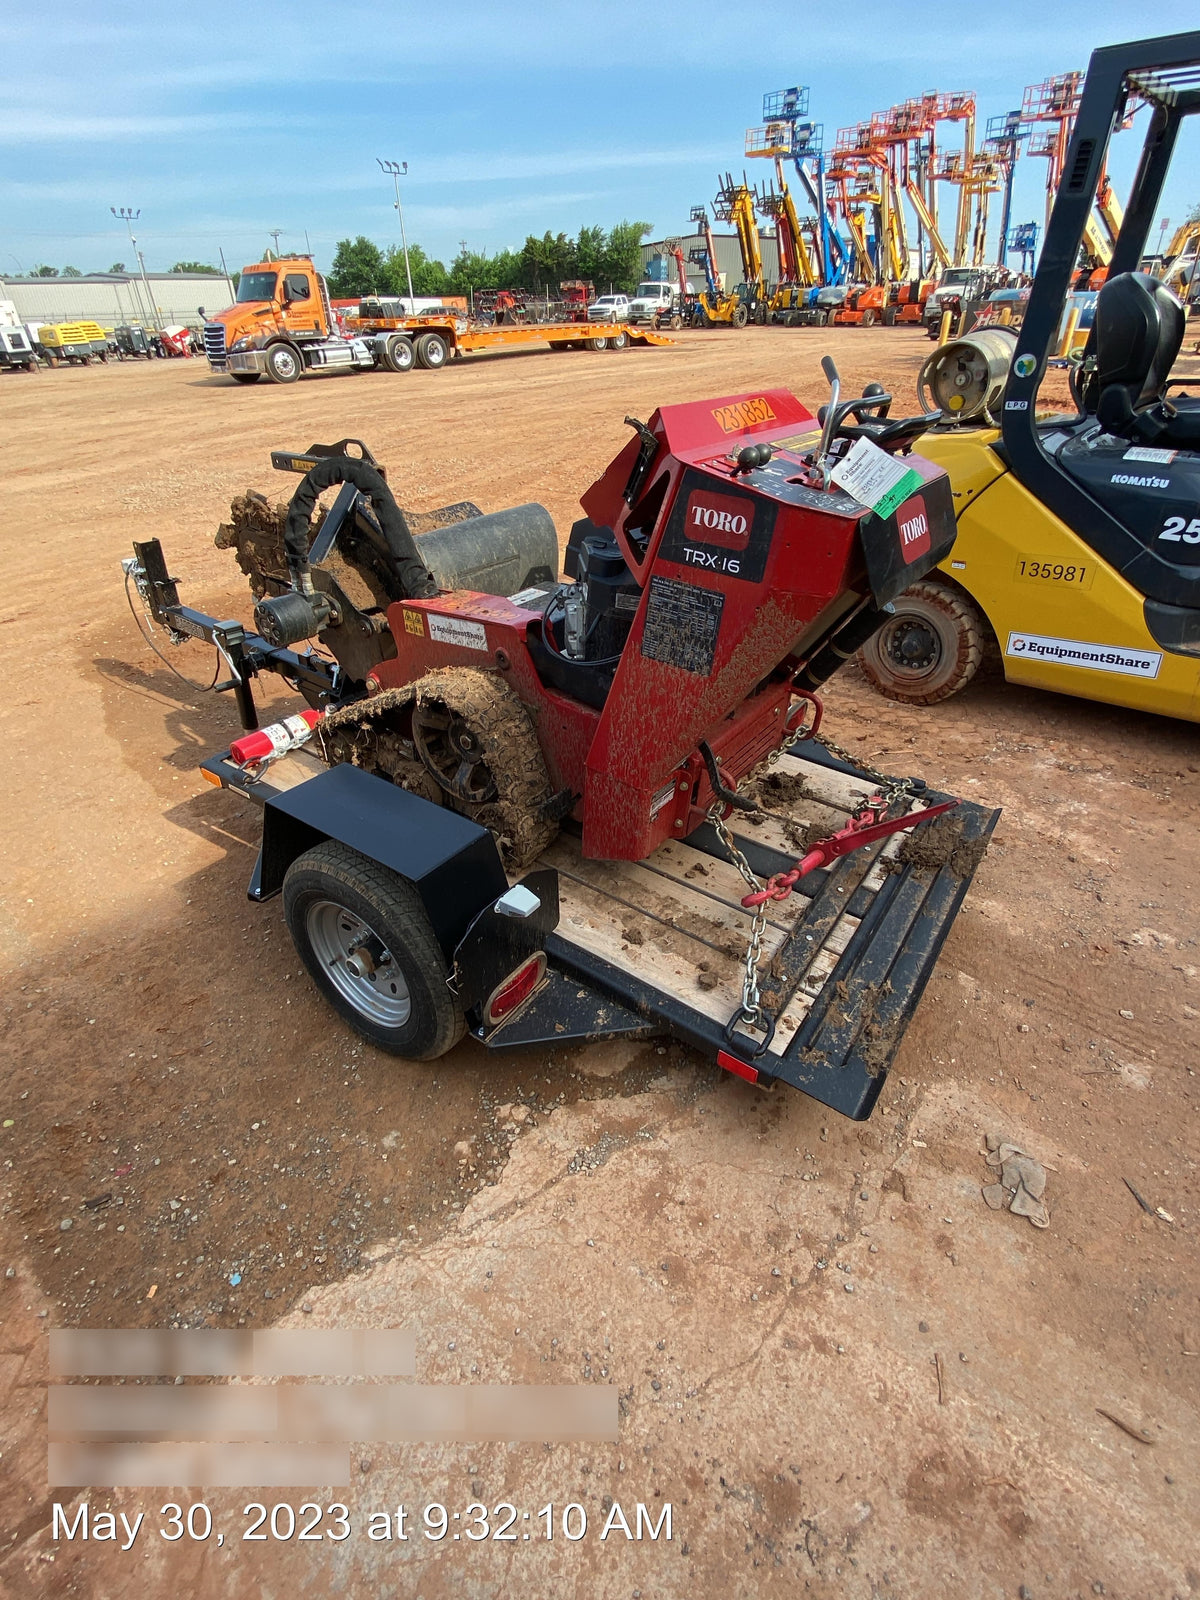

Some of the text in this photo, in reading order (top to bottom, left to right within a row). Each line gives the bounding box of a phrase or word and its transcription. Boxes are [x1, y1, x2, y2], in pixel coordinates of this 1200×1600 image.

[714, 399, 774, 431] 231852
[845, 449, 869, 474] Equipment
[1110, 474, 1170, 488] KOMATSU
[692, 506, 747, 534] TORO
[900, 514, 926, 545] TORO
[1158, 516, 1200, 544] 25
[1019, 561, 1086, 583] 135981
[1027, 641, 1151, 669] EquipmentShare
